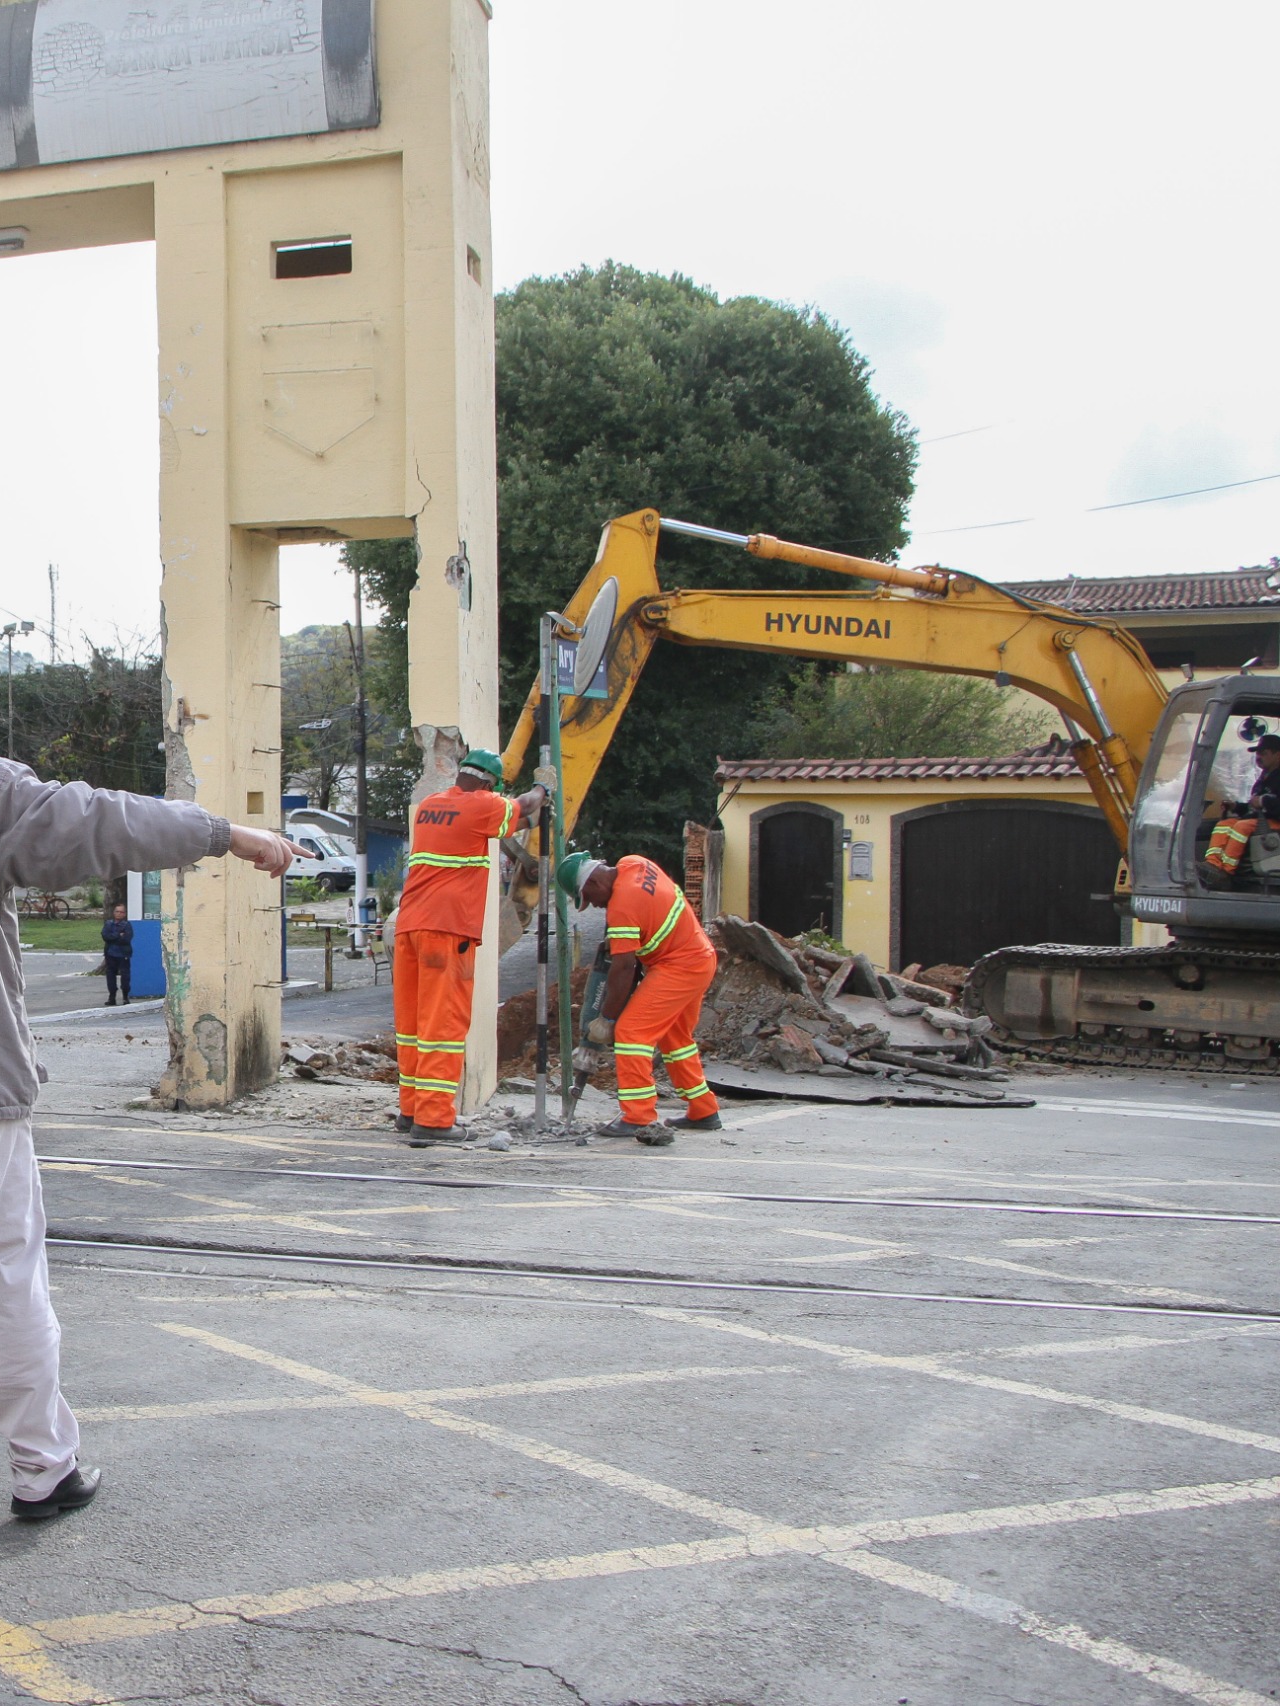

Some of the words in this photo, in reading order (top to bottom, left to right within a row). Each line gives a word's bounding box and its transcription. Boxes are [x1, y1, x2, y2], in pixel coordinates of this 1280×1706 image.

[765, 612, 891, 639] HYUNDAI
[559, 645, 574, 673] Ary
[417, 809, 460, 826] DNIT
[592, 981, 606, 1011] makita
